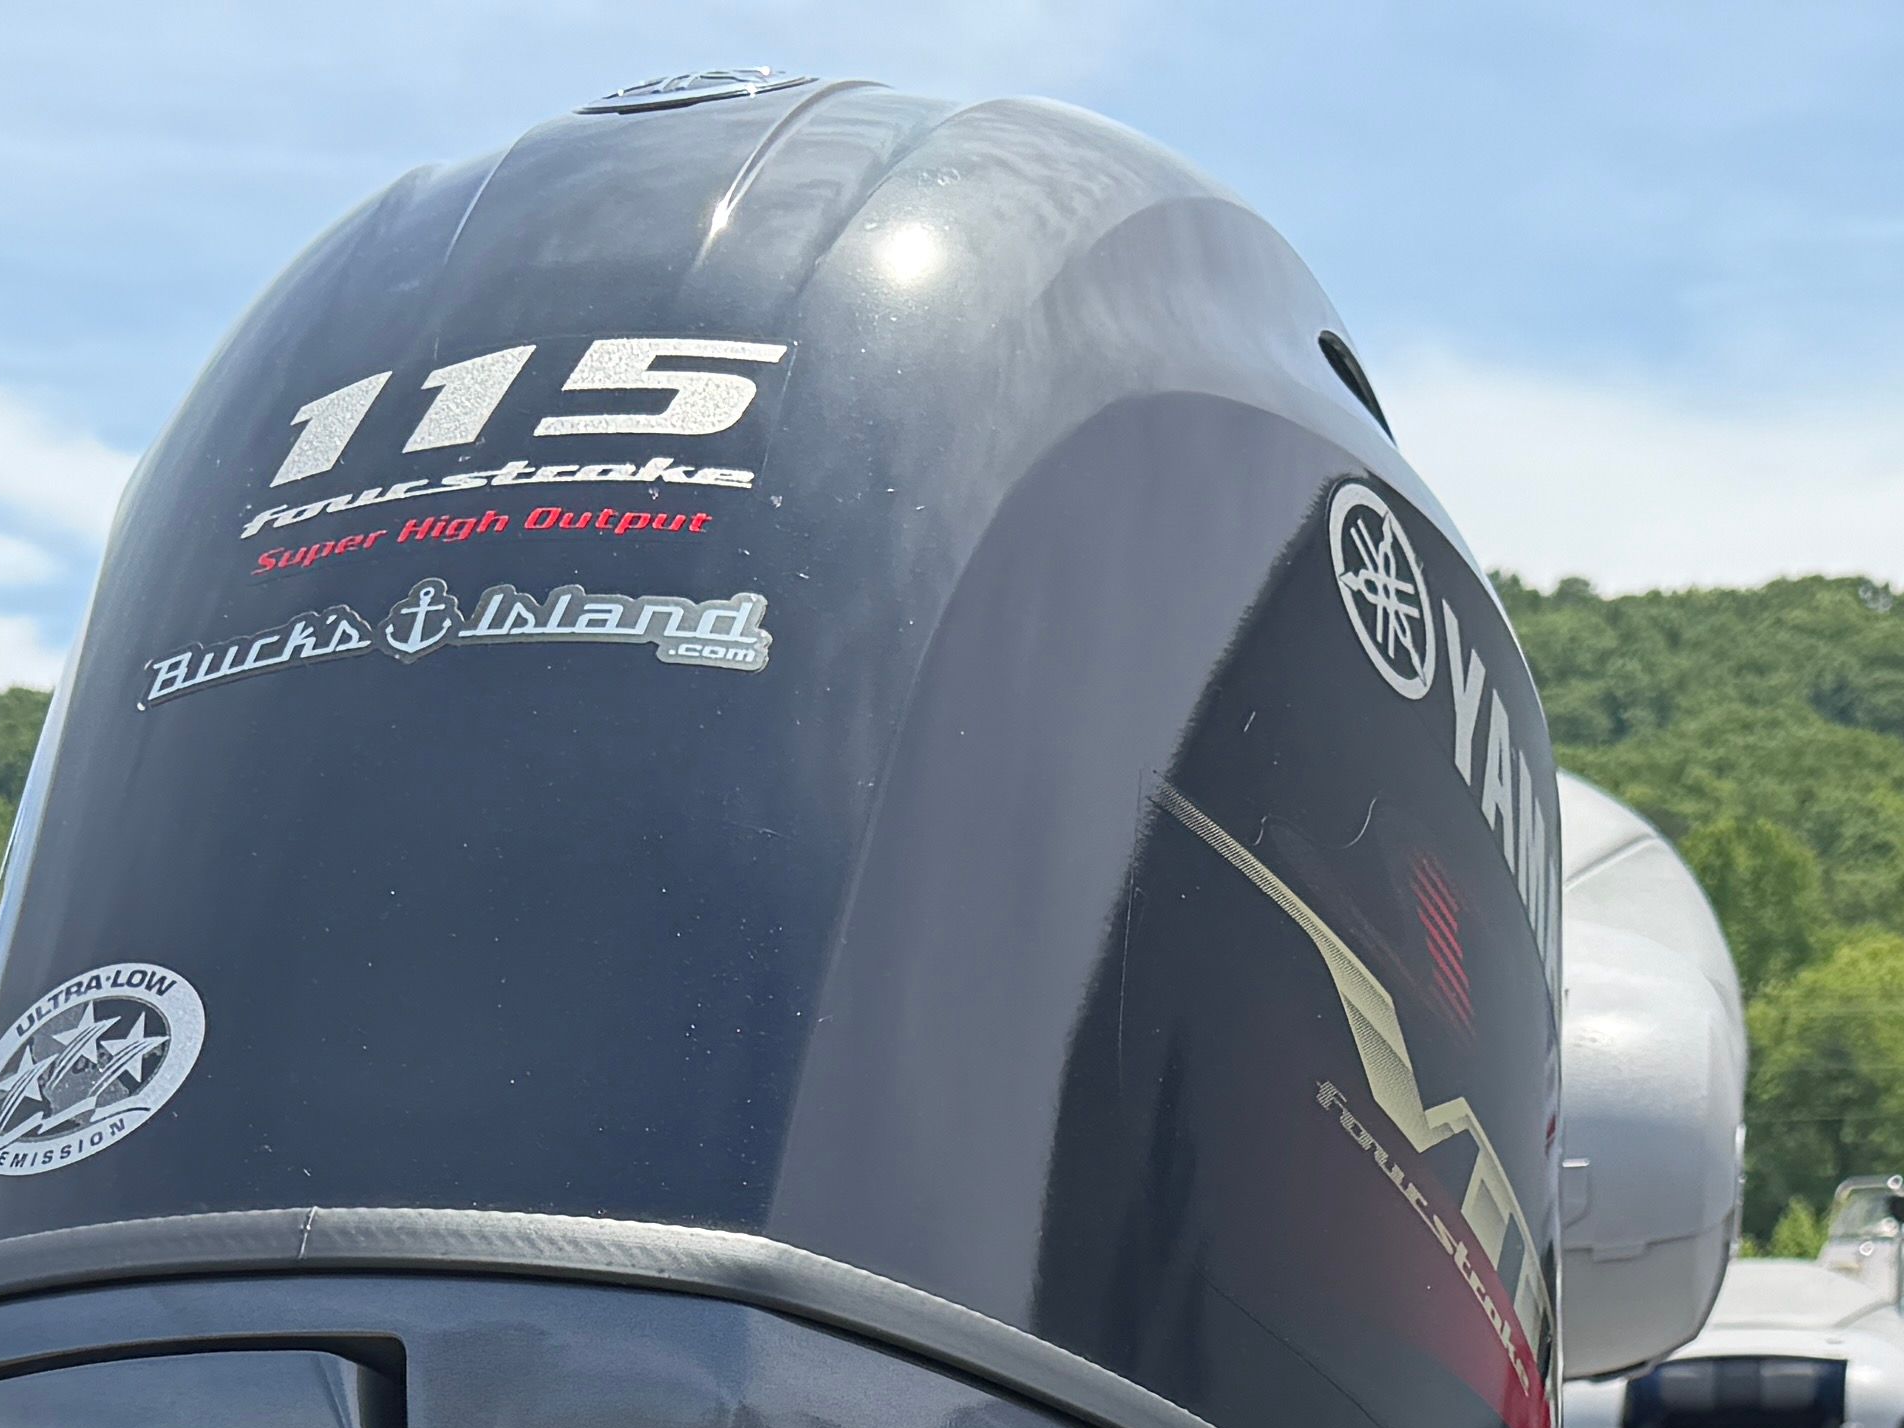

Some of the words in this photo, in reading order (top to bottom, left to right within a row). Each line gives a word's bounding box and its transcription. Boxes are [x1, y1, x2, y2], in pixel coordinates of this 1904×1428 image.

[269, 337, 788, 488] 115
[241, 457, 754, 540] fourstroke
[251, 526, 388, 576] Super
[397, 508, 509, 544] High
[524, 505, 713, 535] Output
[145, 612, 372, 701] Buck's
[459, 591, 759, 646] Island
[668, 644, 757, 663] .com
